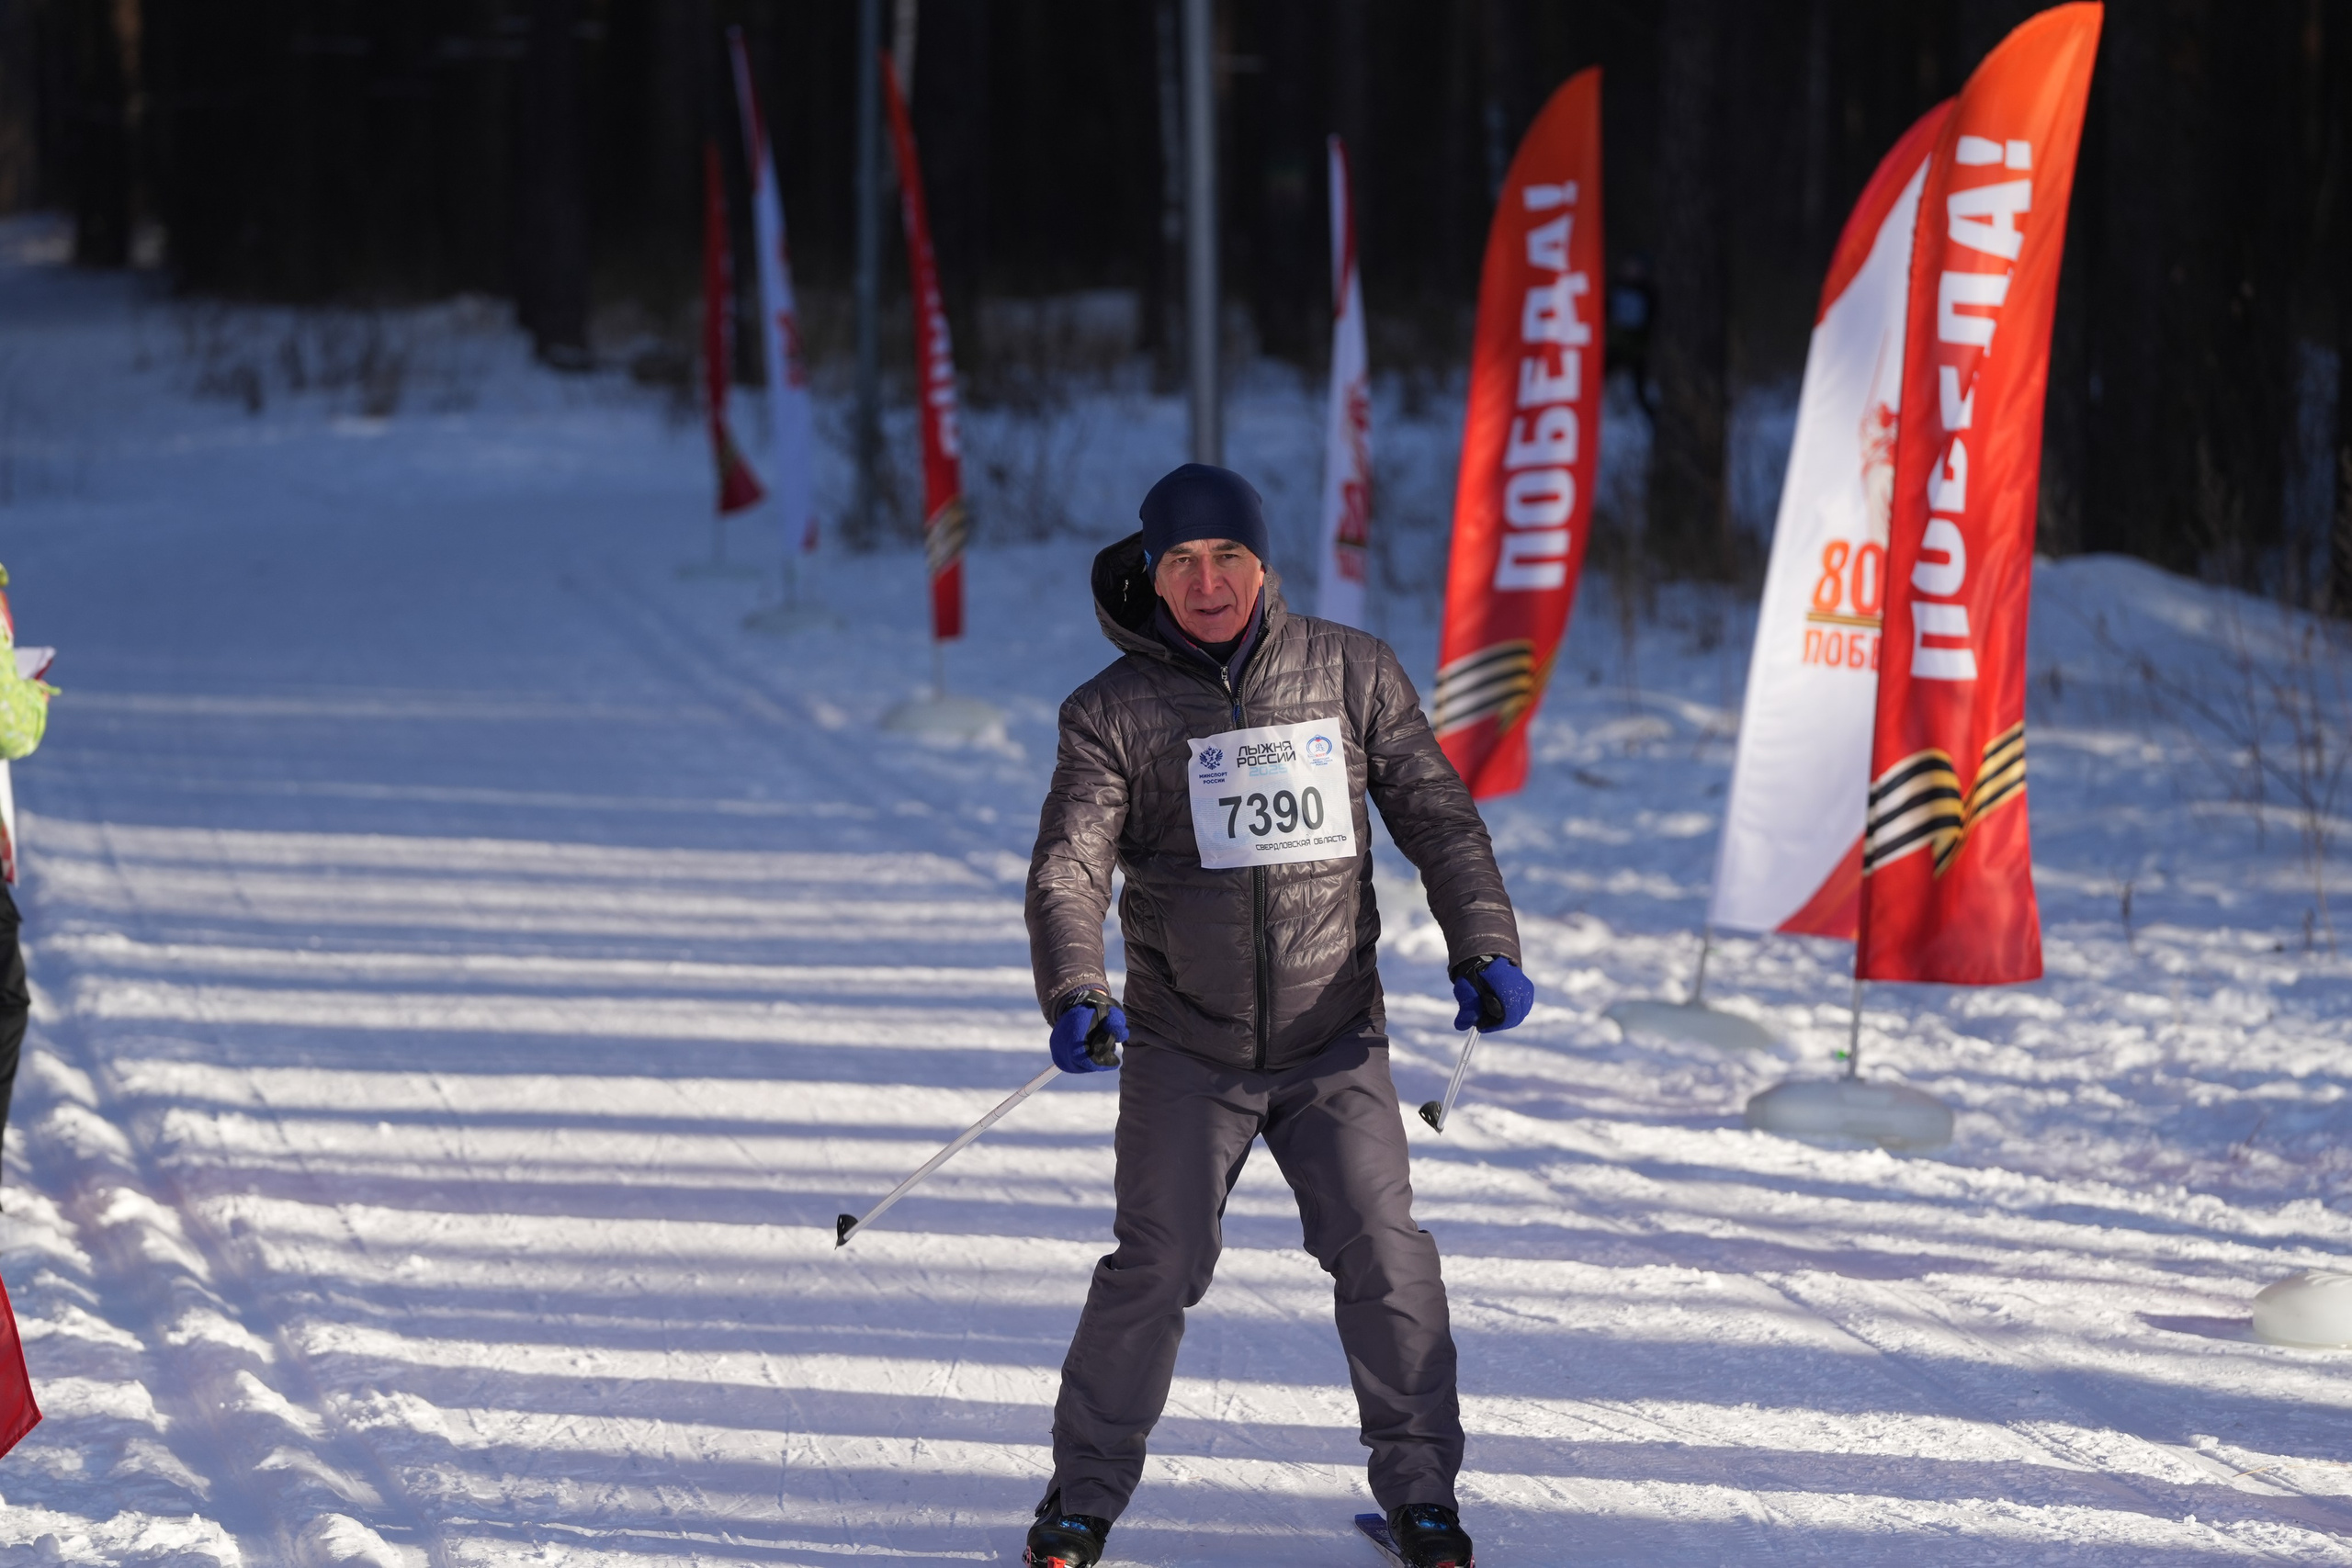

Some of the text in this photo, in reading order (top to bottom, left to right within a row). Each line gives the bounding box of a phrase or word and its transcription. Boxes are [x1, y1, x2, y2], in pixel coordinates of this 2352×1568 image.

[1492, 179, 1591, 591] ПОБЕДА!
[1812, 538, 1884, 616] 80
[1238, 740, 1293, 757] ЛЫЖНЯ
[1236, 750, 1296, 768] РОССИИ
[1249, 763, 1288, 777] 2025
[1218, 785, 1325, 839] 7390
[1255, 834, 1348, 852] СВЕРДЛОВСКАЯ ОБЛАСТЬ
